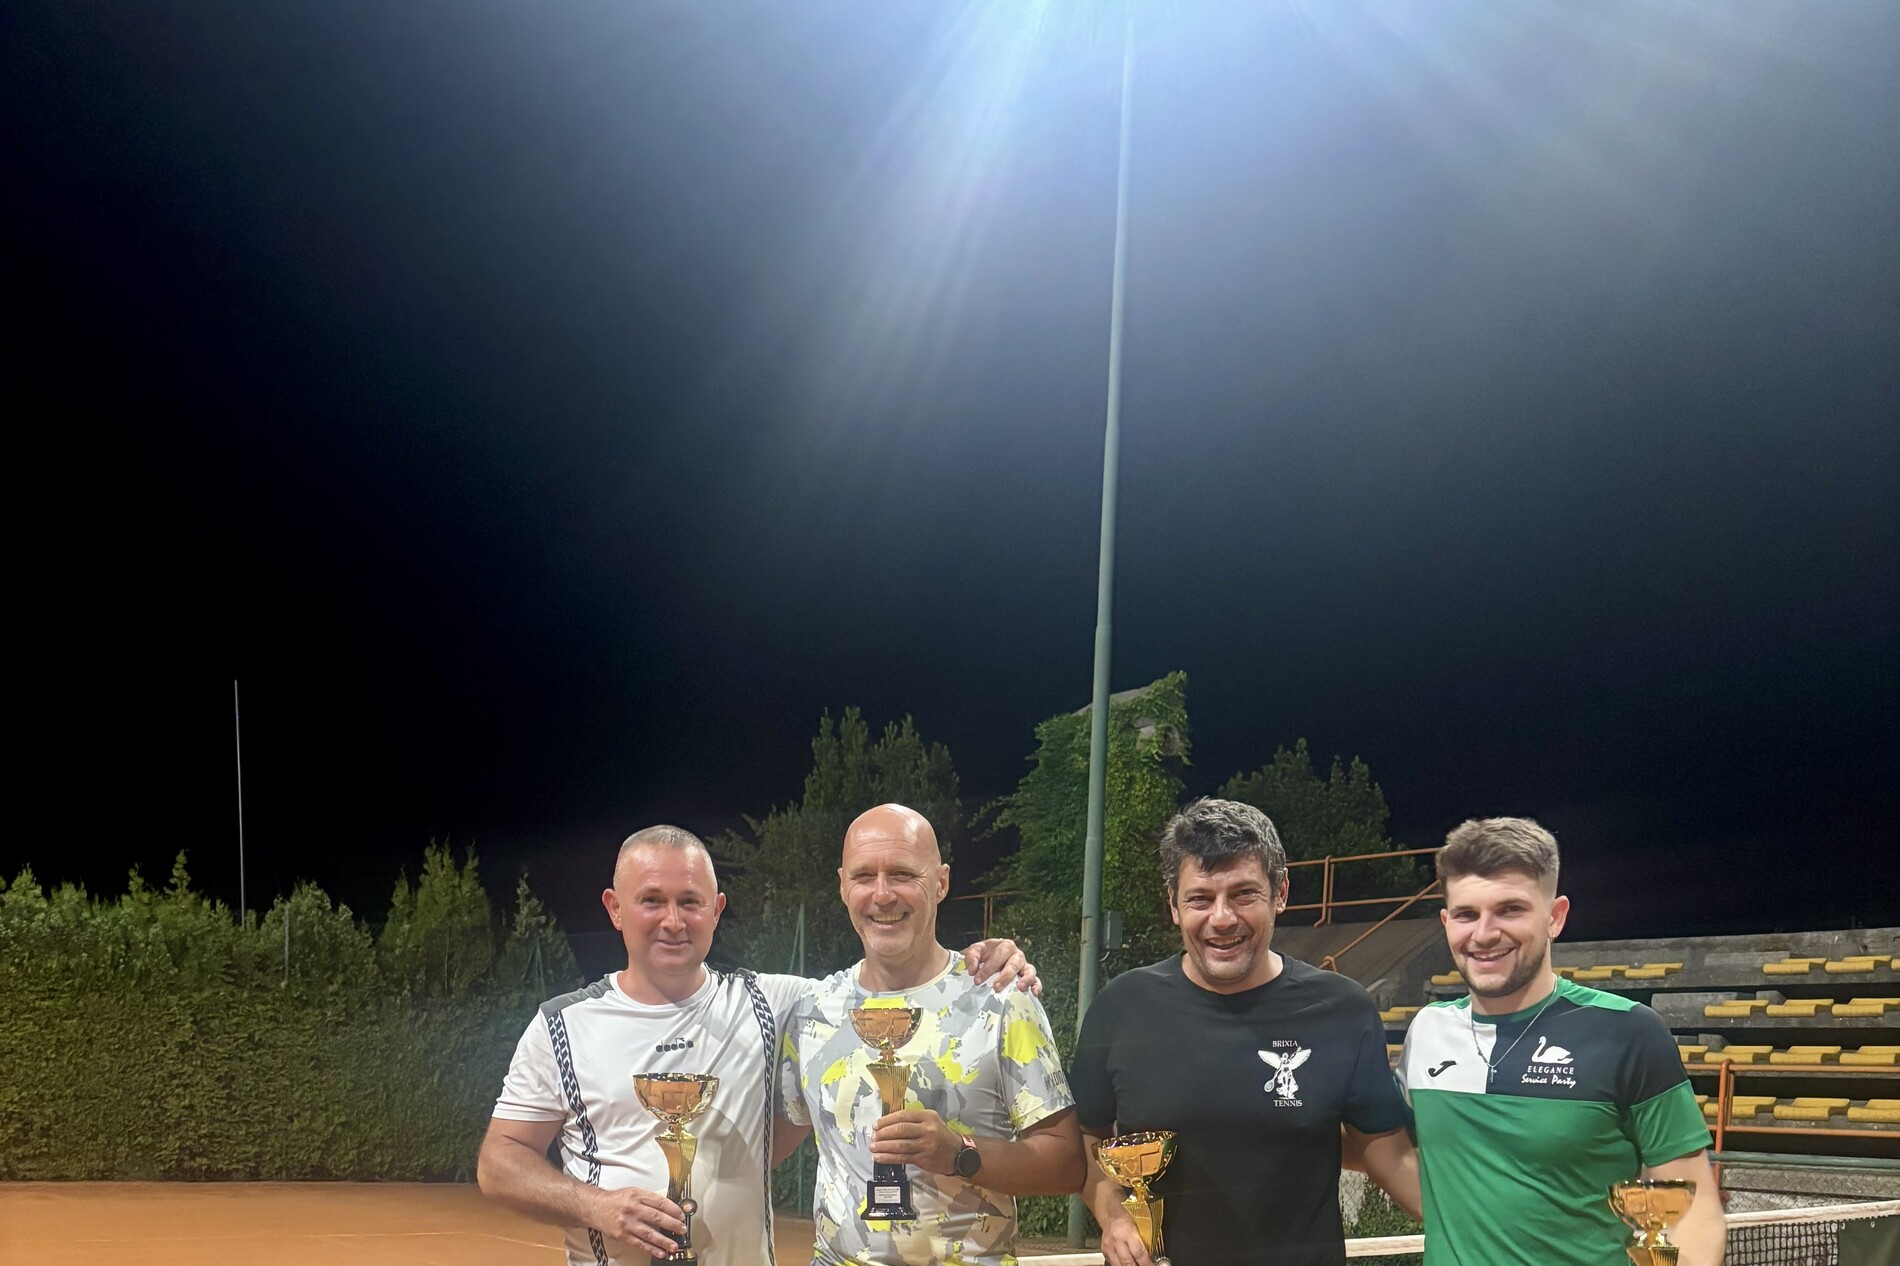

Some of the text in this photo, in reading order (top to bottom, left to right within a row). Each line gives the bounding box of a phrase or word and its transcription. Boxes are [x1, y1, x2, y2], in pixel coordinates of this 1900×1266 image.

[1272, 1040, 1299, 1048] BRIXIA
[1527, 1065, 1575, 1075] ELEGANCE
[1521, 1073, 1576, 1089] Service Party
[1273, 1099, 1303, 1107] TENNIS
